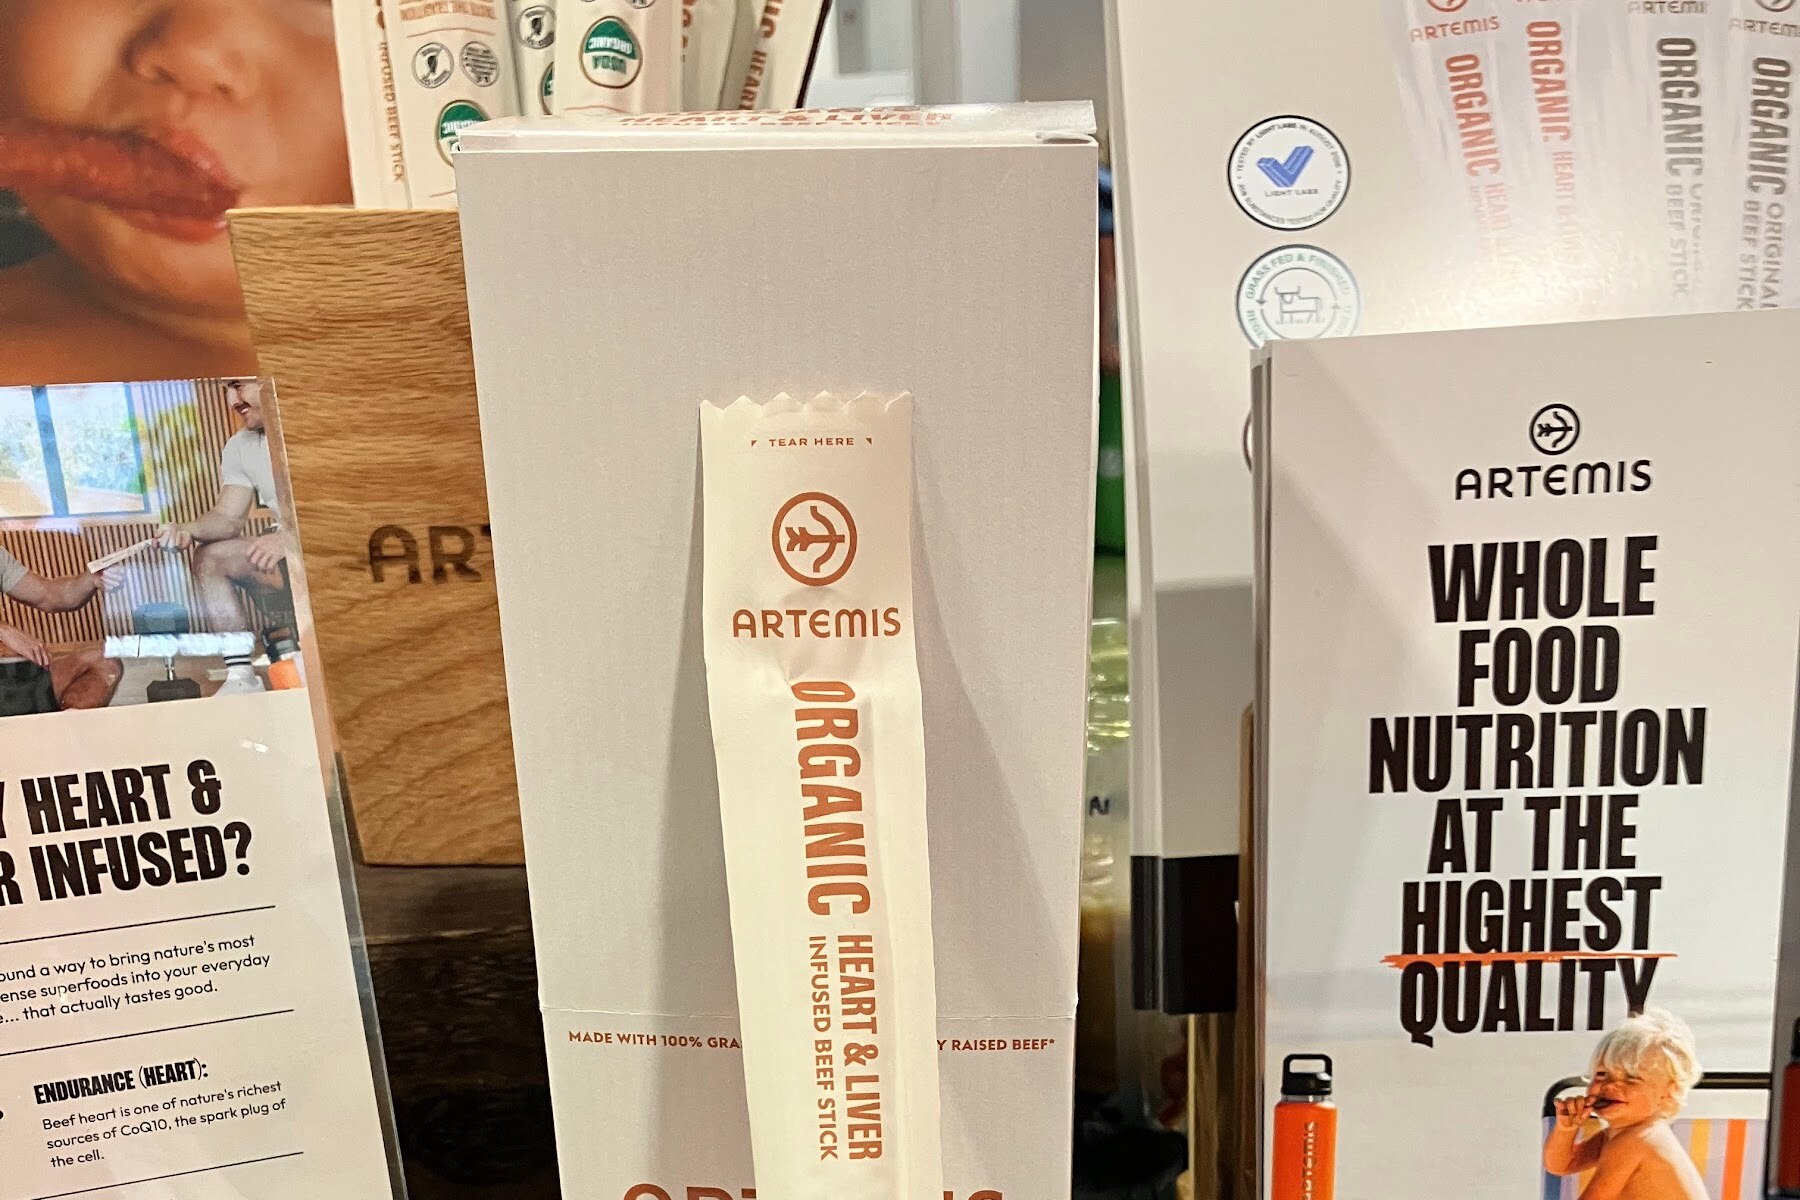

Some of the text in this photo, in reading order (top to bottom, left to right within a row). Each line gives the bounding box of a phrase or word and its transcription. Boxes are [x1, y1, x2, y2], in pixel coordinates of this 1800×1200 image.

[1445, 53, 1502, 177] ORGANIC
[1526, 21, 1572, 143] ORGANIC
[1656, 37, 1704, 178] ORGANIC
[1747, 57, 1792, 196] ORGANIC
[1741, 200, 1762, 248] BEEF
[768, 436, 855, 448] TEAR HERE
[1455, 459, 1652, 500] ARTEMIS
[1427, 535, 1659, 623] WHOLE
[732, 606, 901, 639] ARTEMIS
[1457, 624, 1621, 708] FOOD
[1369, 707, 1707, 794] NUTRITION
[20, 759, 223, 836] HEART &
[1427, 794, 1639, 874] AT THE
[29, 821, 252, 902] INFUSED?
[791, 680, 883, 1160] ORGANIC HEART & LIVER
[1401, 876, 1662, 955] HIGHEST
[40, 935, 255, 976] a way to bring nature's most
[41, 954, 270, 997] superfoods into your everyday
[22, 980, 217, 1020] that actually tastes good.
[568, 1029, 702, 1048] MADE WITH 100%
[1399, 956, 1661, 1049] QUALITY
[33, 1058, 208, 1104] ENDURANCE (HEART):
[808, 935, 839, 1161] INFUSED BEEF STICK
[951, 1039, 1008, 1051] RAISED
[43, 1081, 281, 1130] Beef heart is one of nature's richest
[47, 1098, 286, 1149] sources of CoQ10, the spark plug of
[50, 1149, 104, 1167] the cell.
